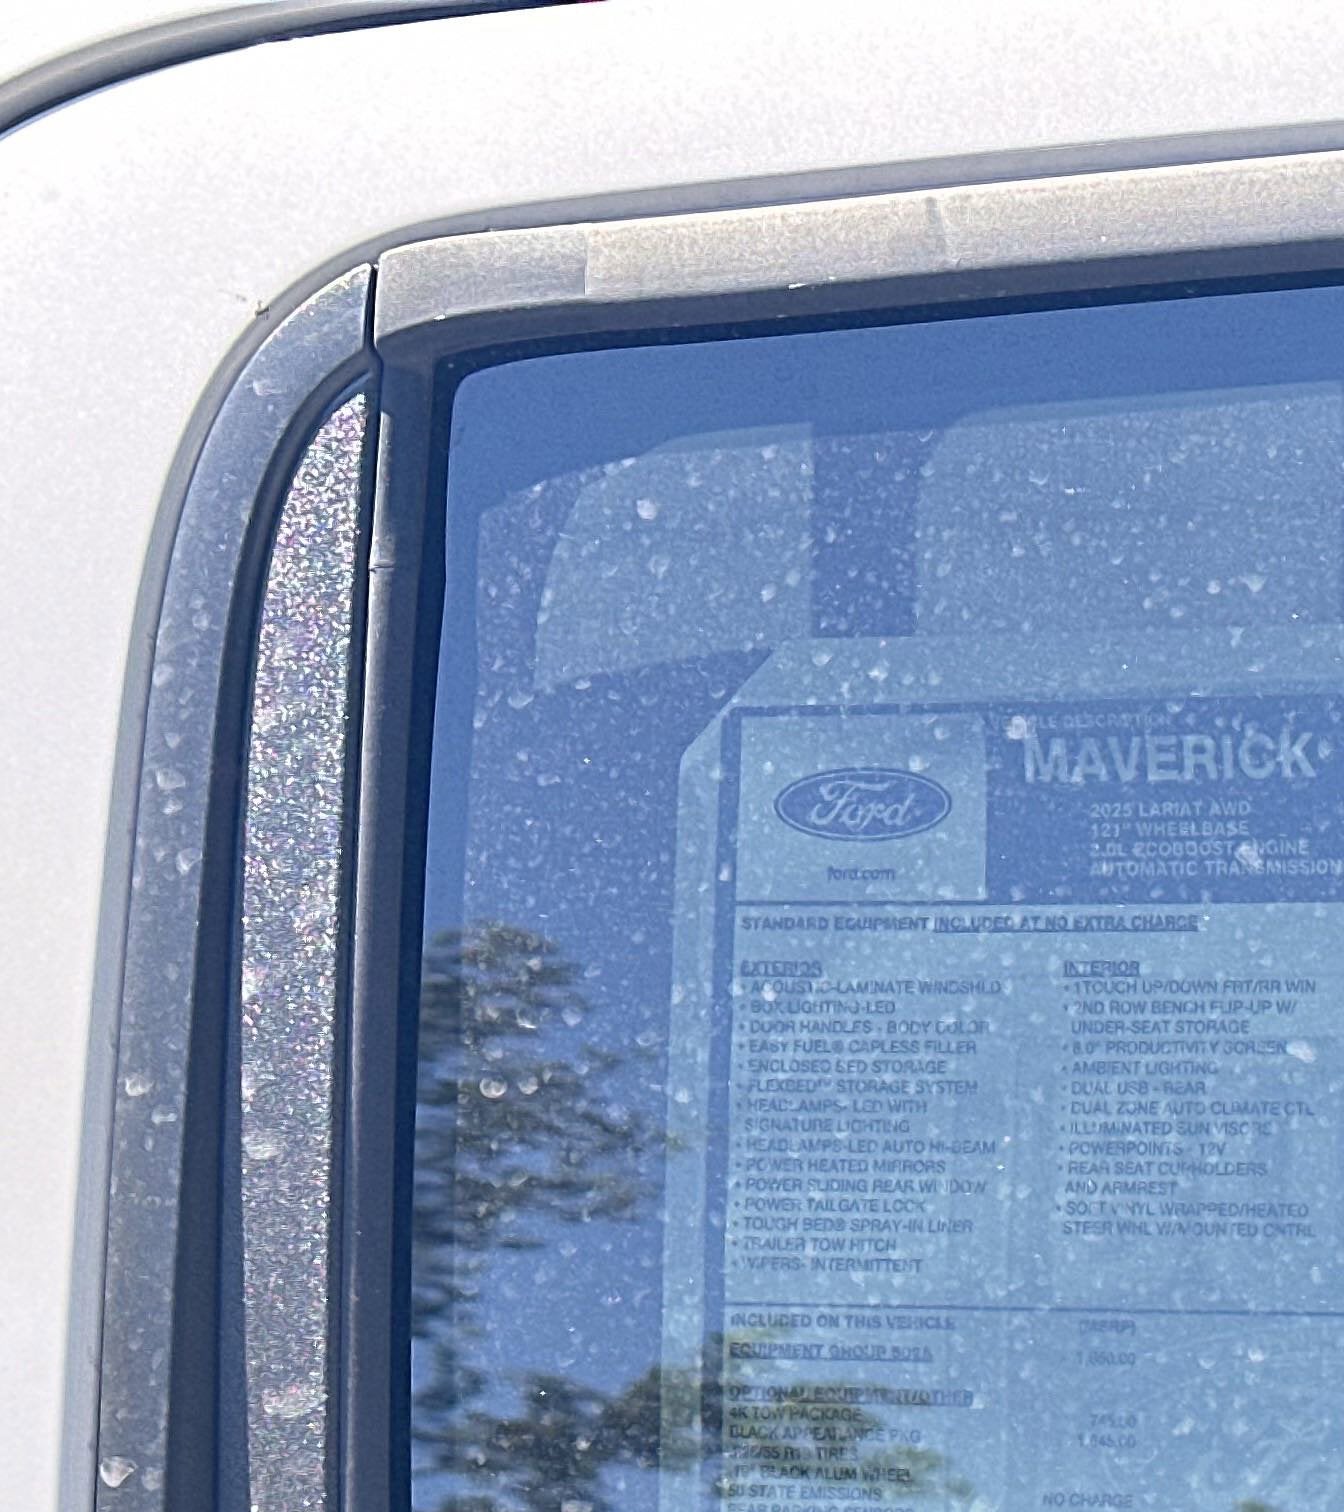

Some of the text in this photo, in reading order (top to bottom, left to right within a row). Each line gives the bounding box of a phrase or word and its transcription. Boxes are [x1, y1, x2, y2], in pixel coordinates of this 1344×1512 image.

[1023, 732, 1318, 784] MAVERICK
[1208, 801, 1251, 816] AWD
[827, 866, 896, 883] ford.com
[1090, 859, 1199, 877] AUTOMATIC
